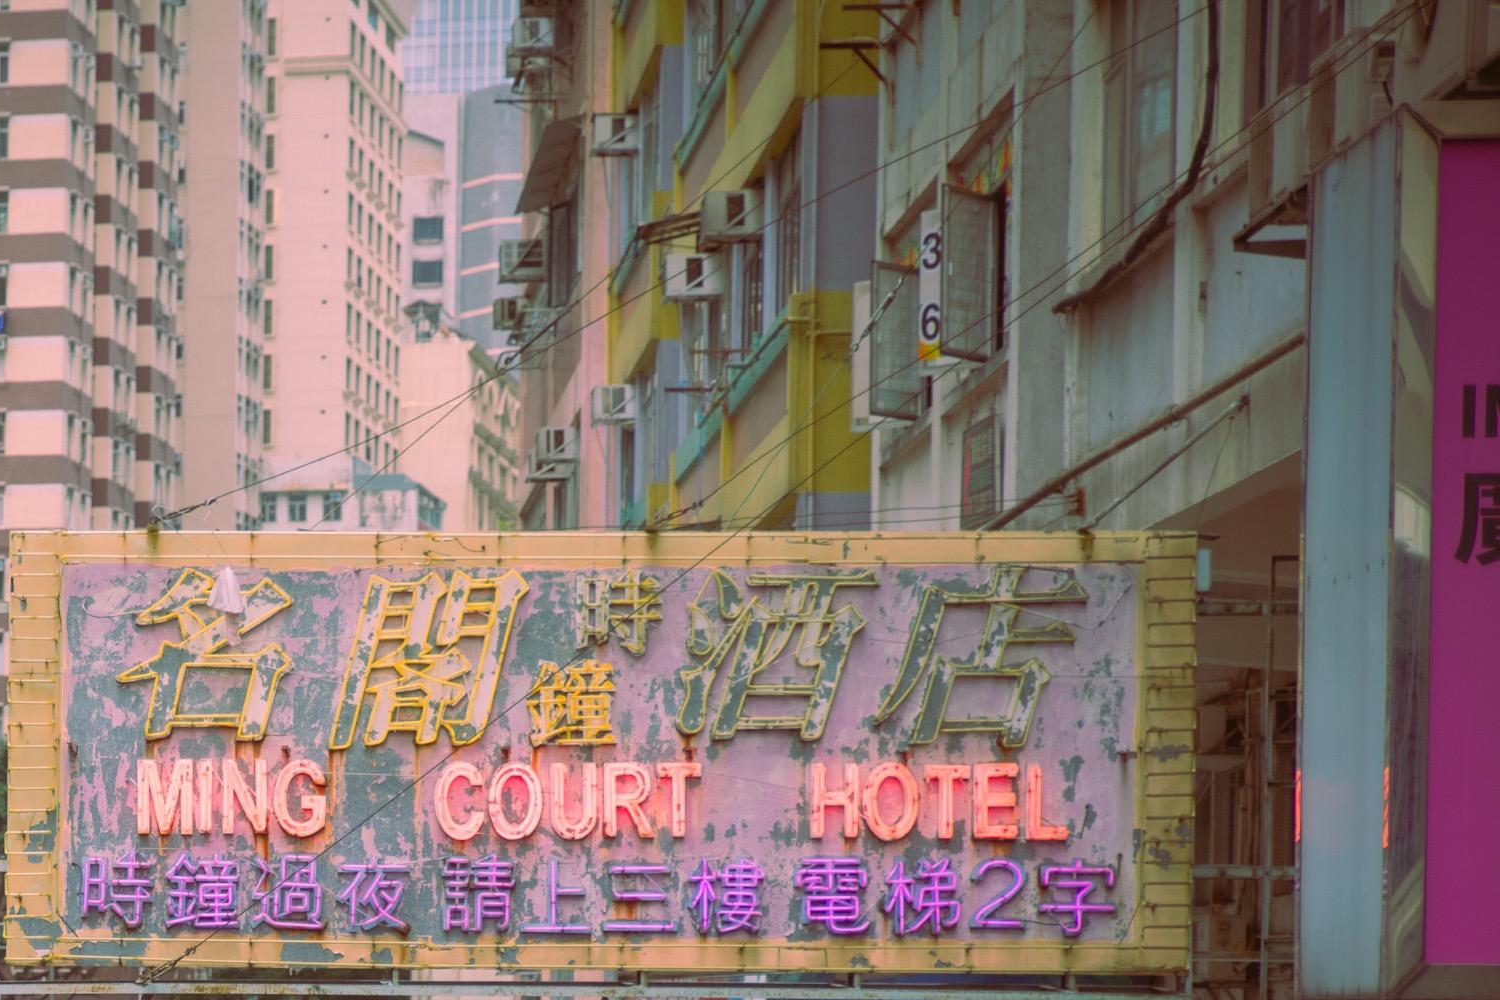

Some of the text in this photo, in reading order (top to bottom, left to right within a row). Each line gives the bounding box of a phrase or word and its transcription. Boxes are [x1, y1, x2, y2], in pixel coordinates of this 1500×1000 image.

[676, 564, 1089, 747] 酒店
[136, 757, 1070, 842] MING COURT HOTEL
[80, 849, 1117, 937] 時鐘過夜 請上三樓 電梯2字
